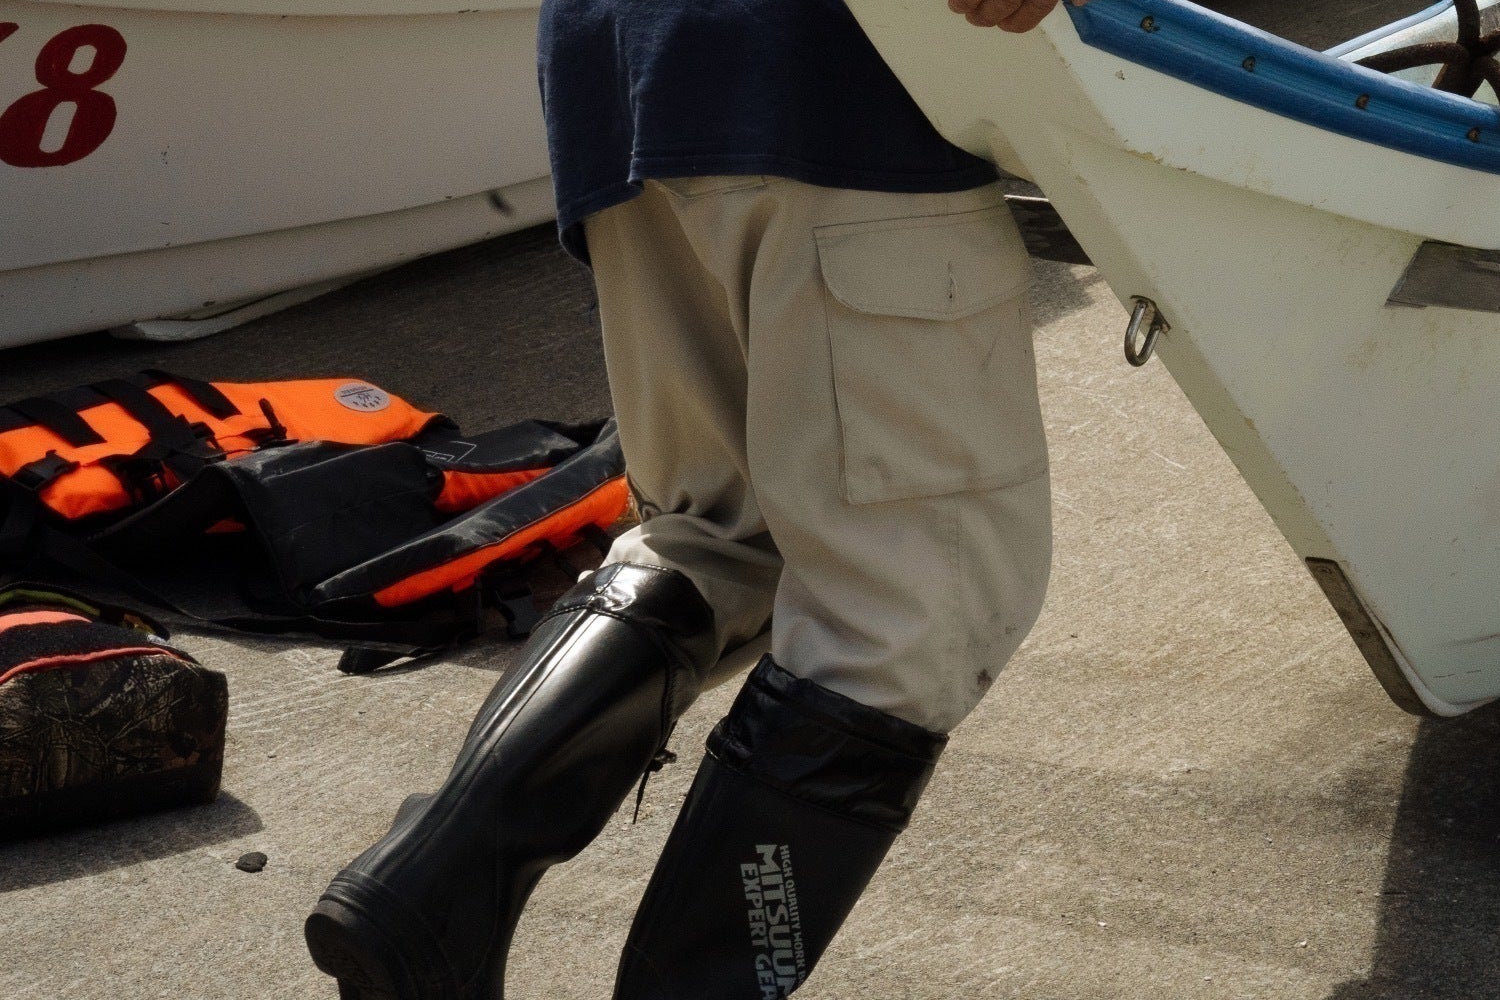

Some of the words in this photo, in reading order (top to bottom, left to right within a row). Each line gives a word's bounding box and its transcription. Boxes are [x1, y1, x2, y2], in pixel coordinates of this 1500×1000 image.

[0, 21, 128, 168] 8
[779, 844, 793, 878] HIGH
[740, 862, 769, 949] EXPERT
[785, 878, 802, 934] QUALITY
[793, 932, 806, 971] WORK
